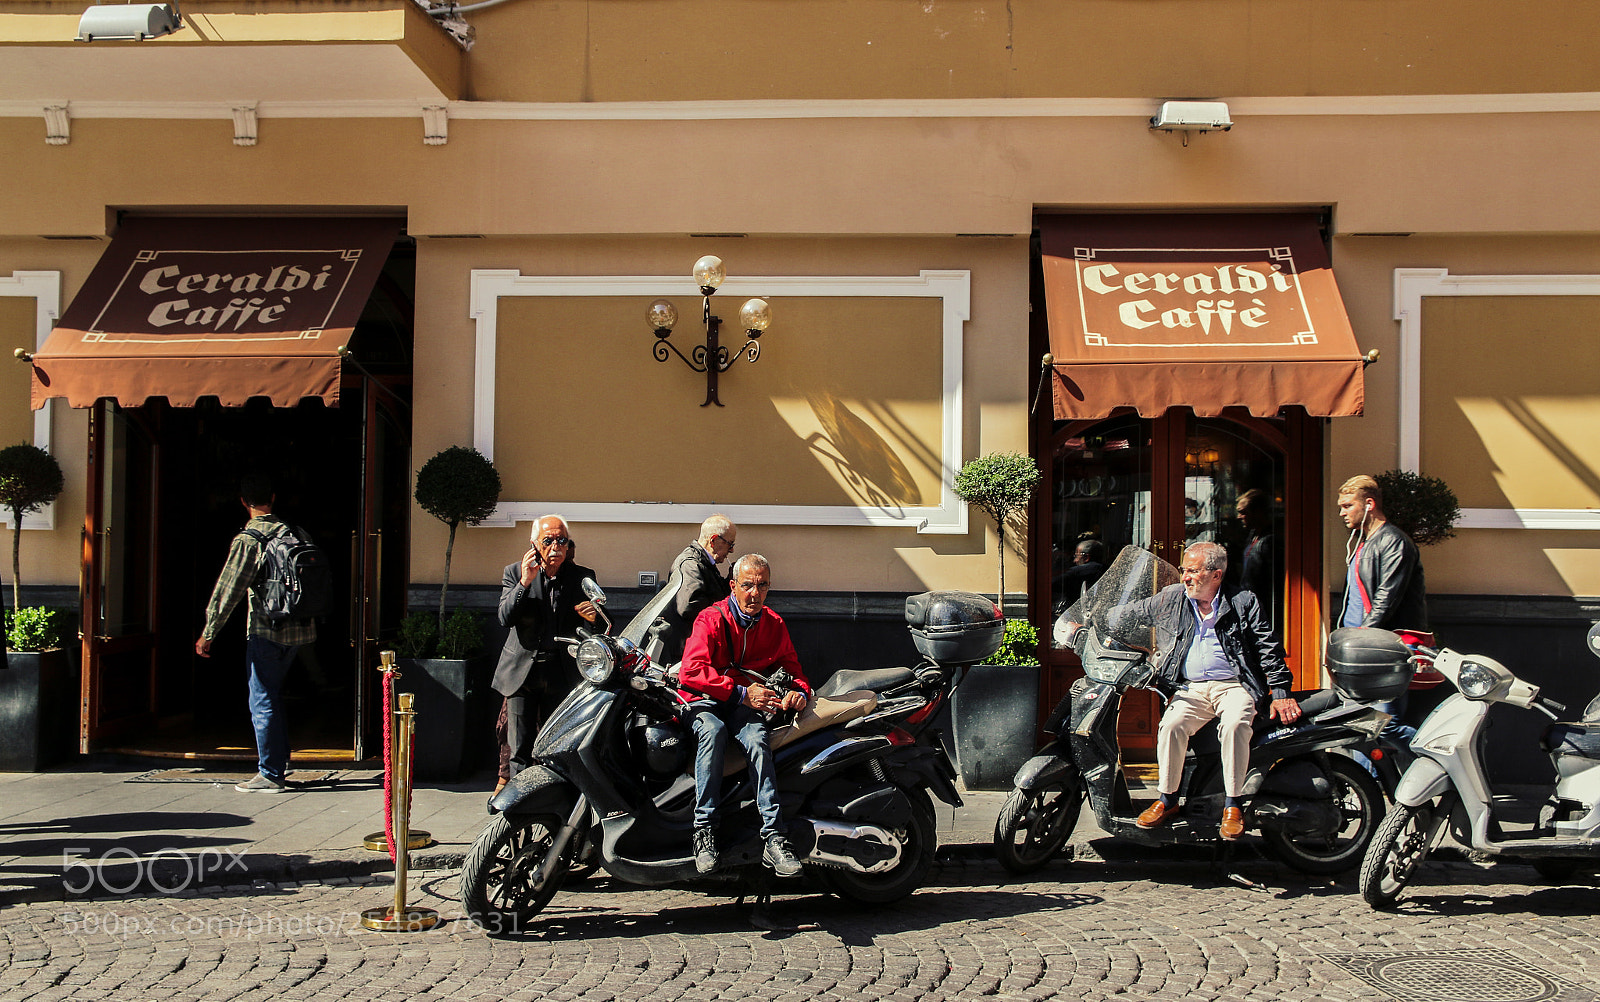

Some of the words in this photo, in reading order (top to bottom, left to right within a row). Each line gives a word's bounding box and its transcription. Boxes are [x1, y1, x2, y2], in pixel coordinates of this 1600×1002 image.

[139, 264, 332, 295] Ceraldi
[1083, 263, 1293, 295] Ceraldi
[147, 296, 292, 331] Caffè
[1118, 298, 1270, 335] Caffè
